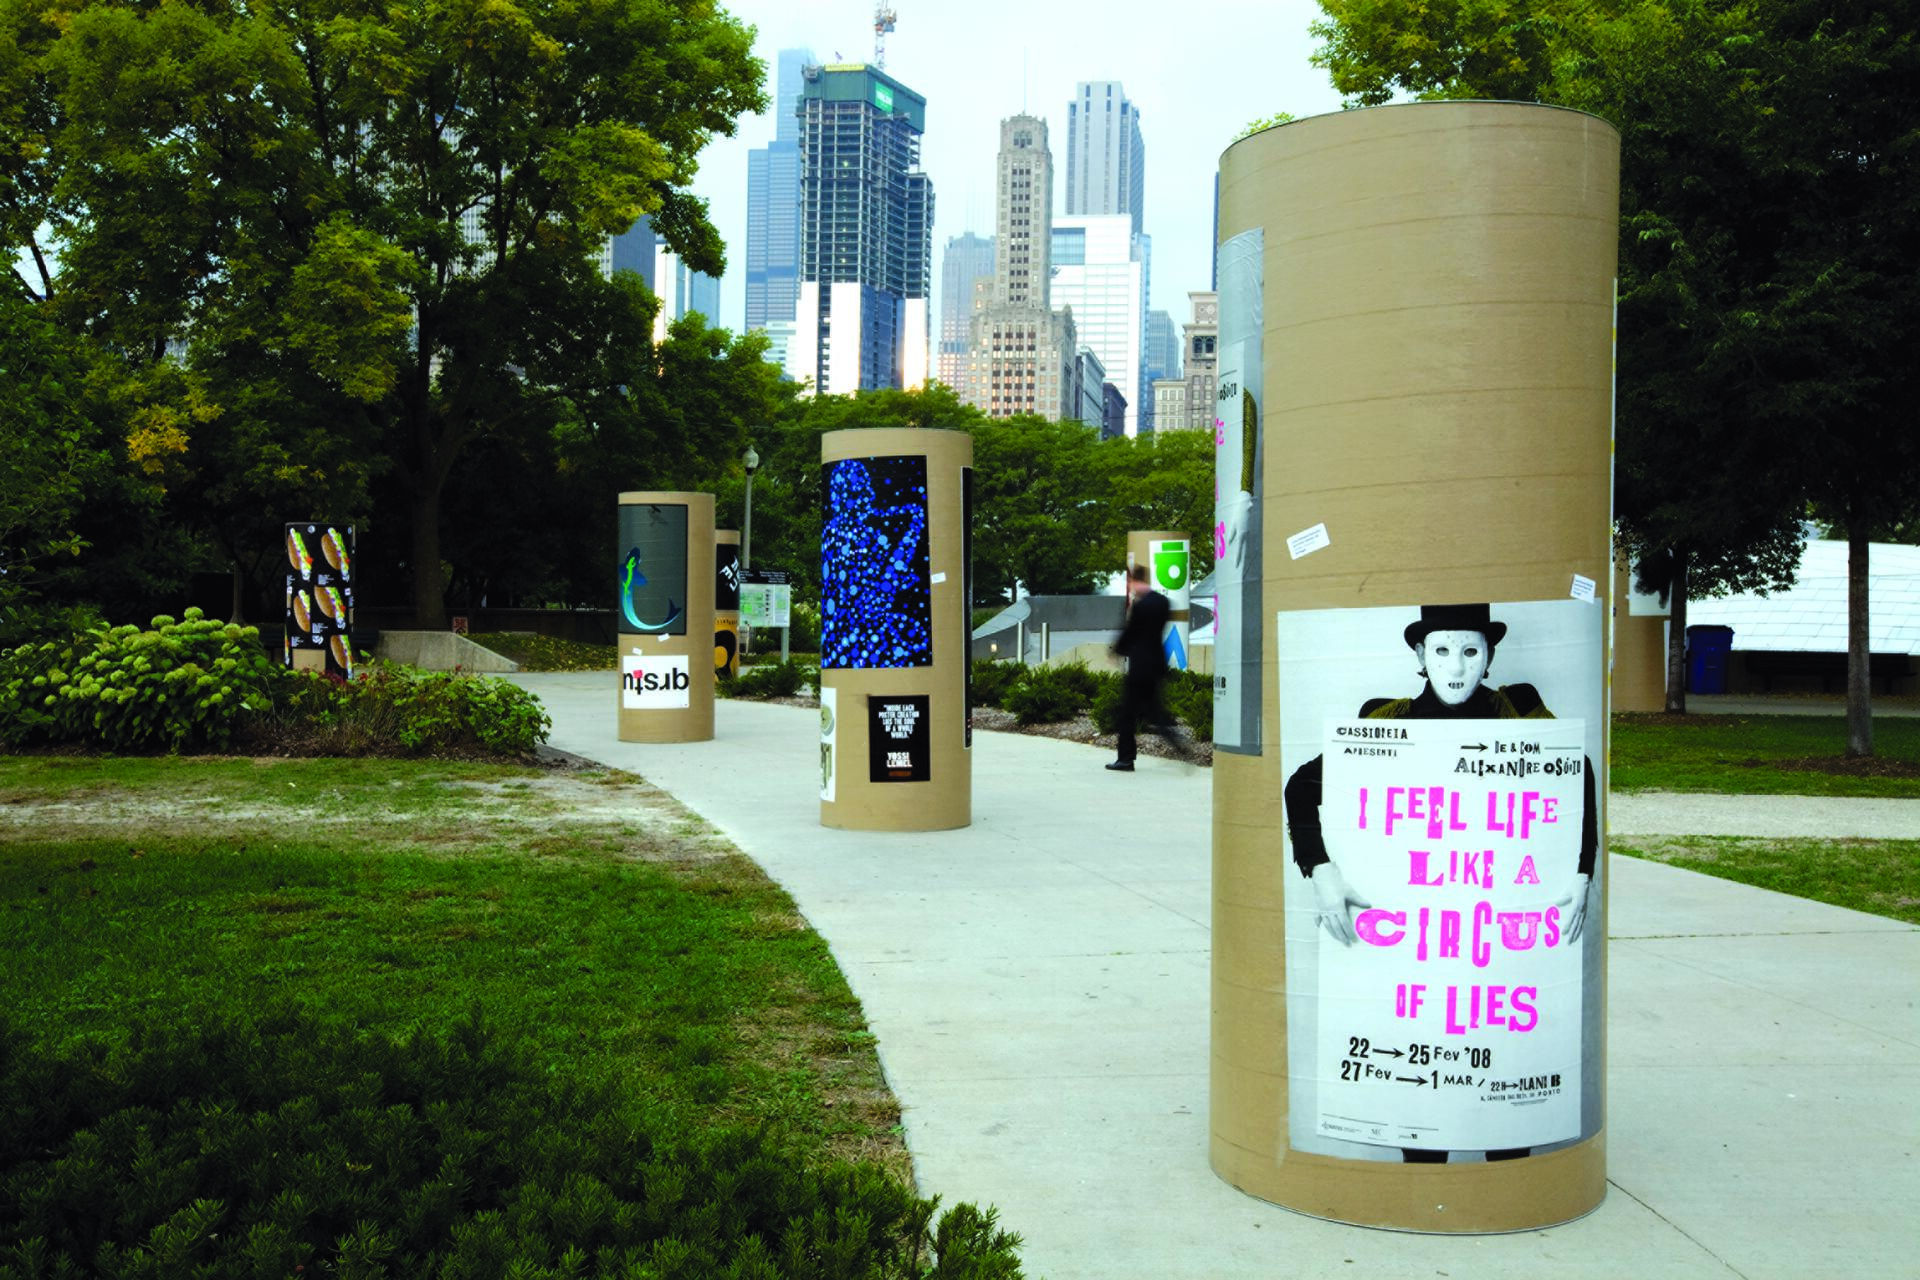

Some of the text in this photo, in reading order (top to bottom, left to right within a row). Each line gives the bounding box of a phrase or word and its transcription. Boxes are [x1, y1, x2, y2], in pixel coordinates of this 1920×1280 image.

[1453, 756, 1541, 778] ALEXANDRE
[1359, 786, 1559, 840] I FEEL LIFE
[1407, 850, 1541, 889] LIKE A
[1355, 900, 1561, 968] CIRCUS
[1395, 983, 1539, 1035] OF LIES
[1348, 1036, 1370, 1059] 22
[1408, 1043, 1430, 1065] 25
[1433, 1046, 1460, 1062] Fev
[1340, 1059, 1362, 1082] 27
[1365, 1063, 1392, 1081] Fev
[1430, 1069, 1438, 1090] 1
[1443, 1075, 1473, 1086] MAR
